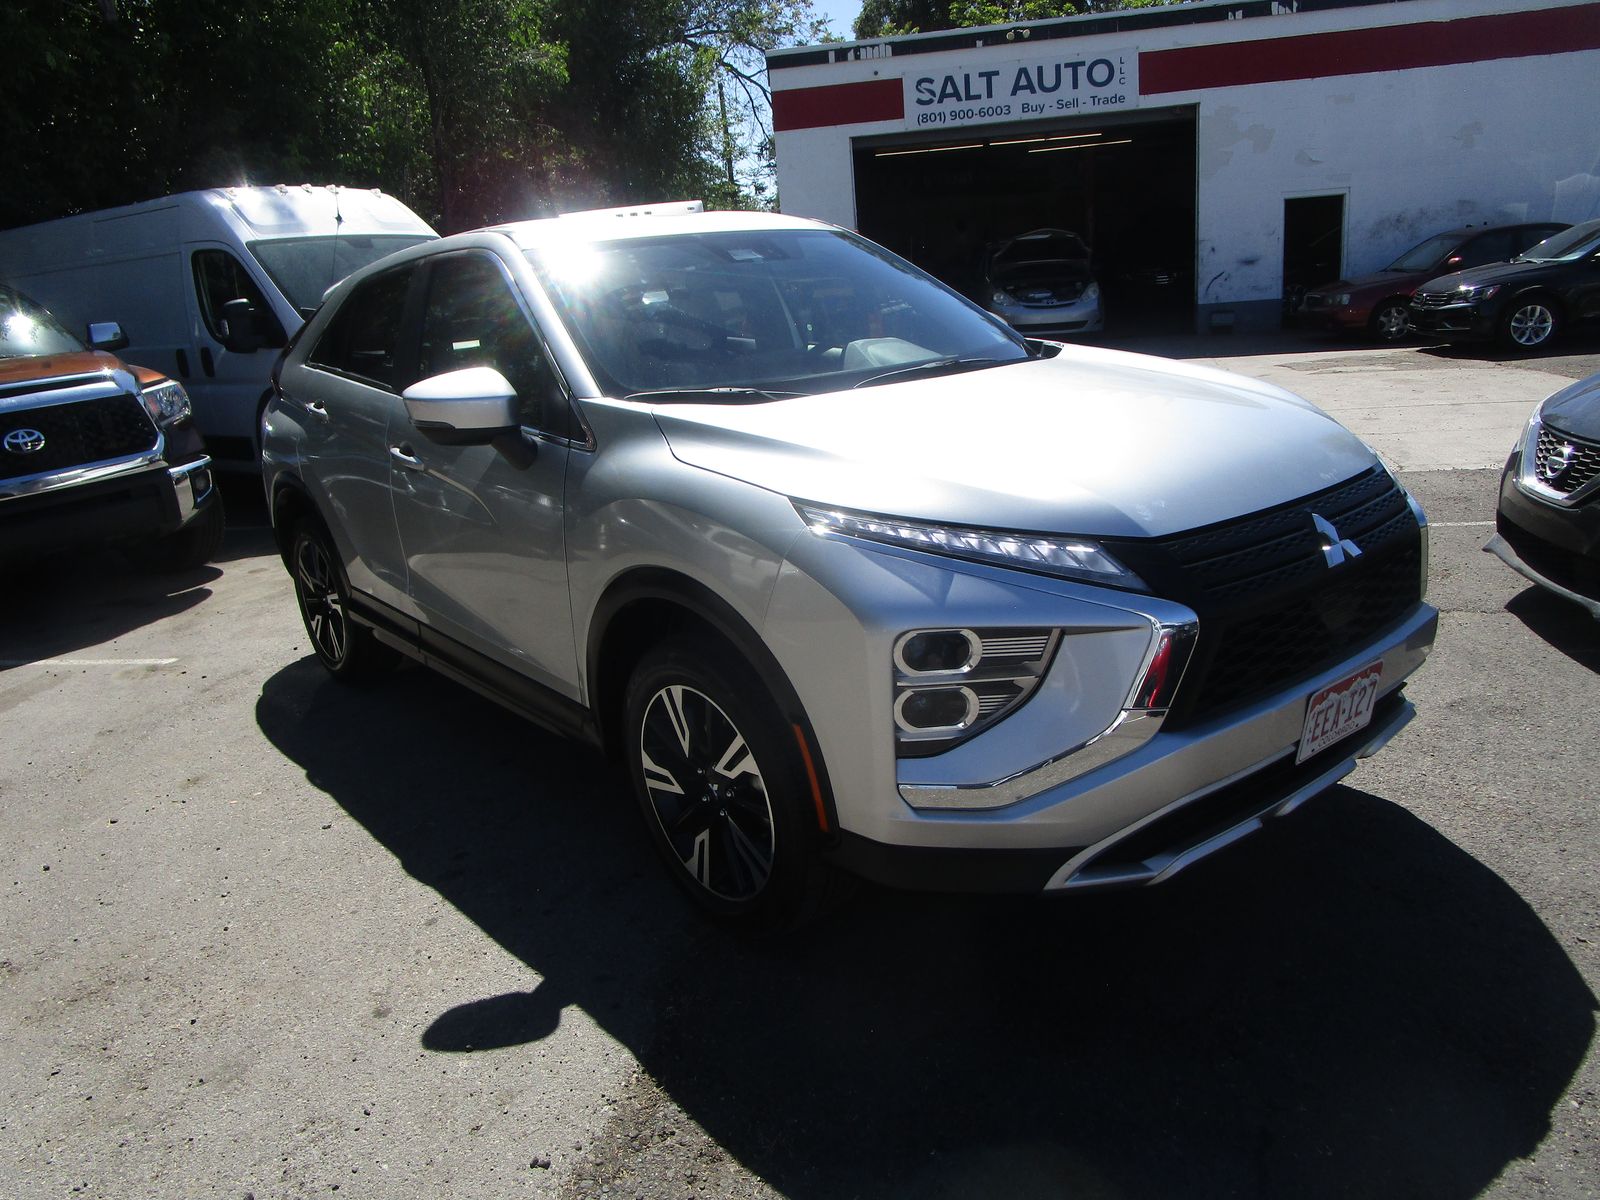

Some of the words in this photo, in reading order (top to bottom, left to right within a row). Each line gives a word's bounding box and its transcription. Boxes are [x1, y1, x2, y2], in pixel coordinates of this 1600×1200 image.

[915, 70, 1000, 106] SALT
[1010, 58, 1115, 97] AUTO
[1118, 56, 1126, 86] LLC
[917, 111, 946, 126] (801)
[950, 104, 1011, 121] 900-6003
[1021, 102, 1046, 116] Buy
[1056, 98, 1079, 110] Sell
[1090, 93, 1126, 107] Trade
